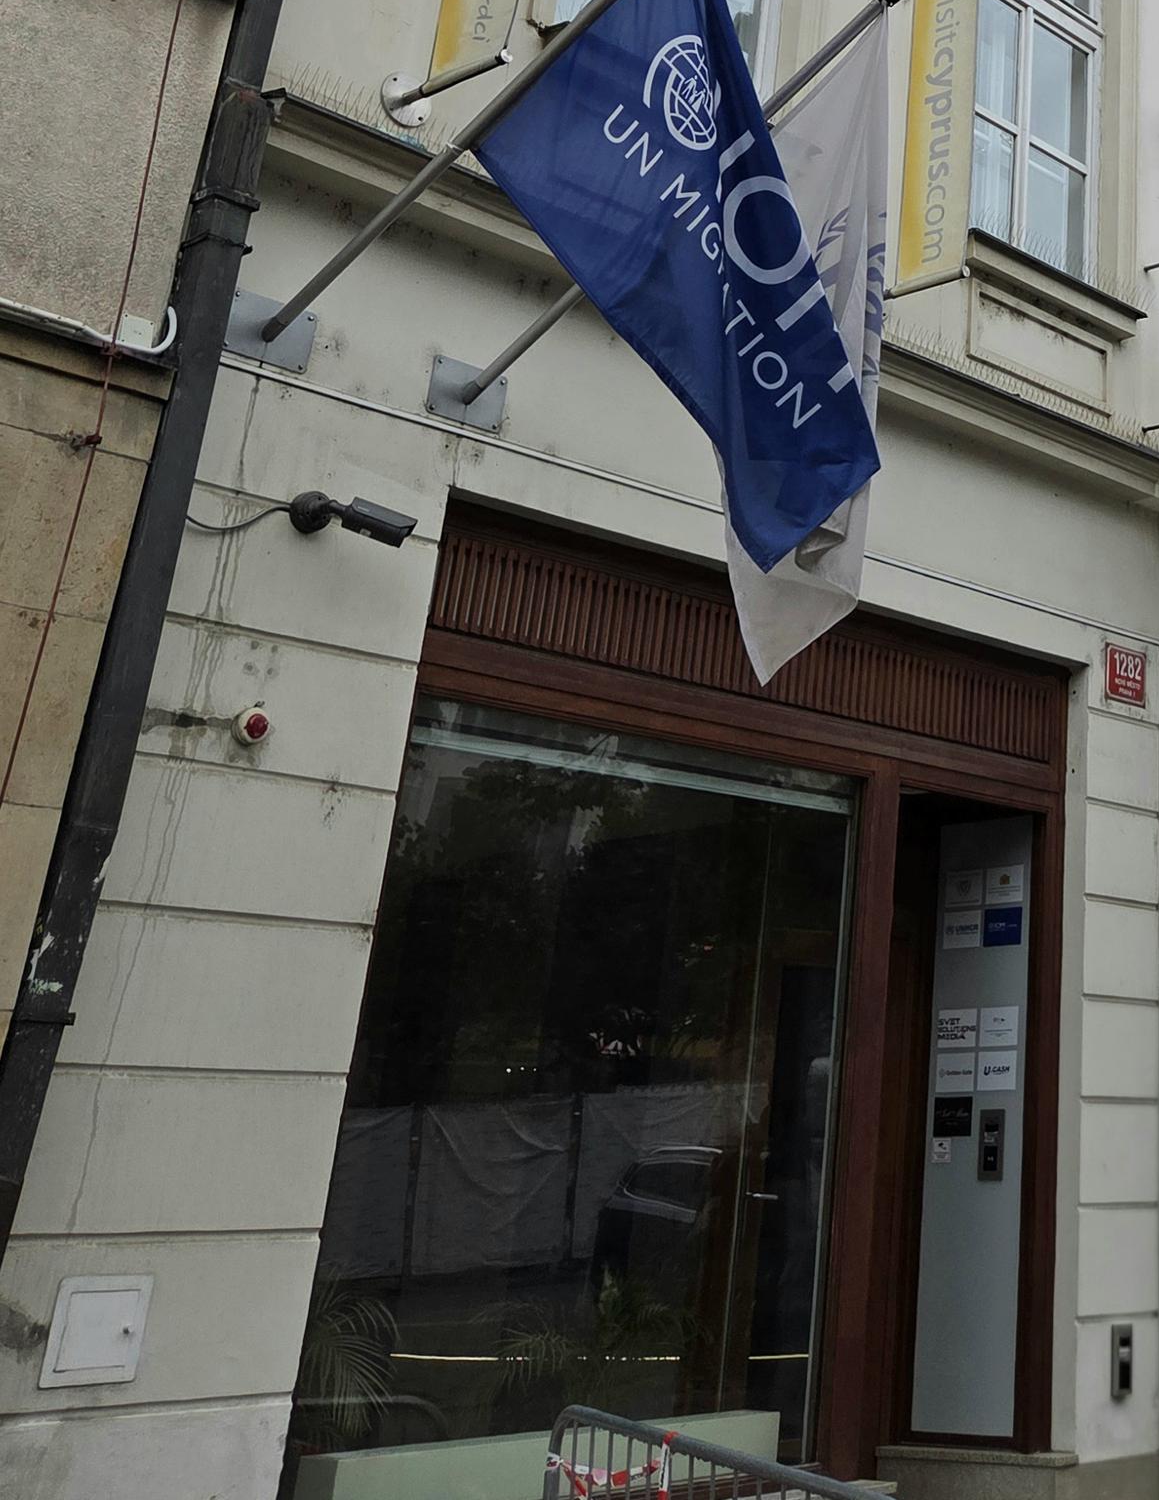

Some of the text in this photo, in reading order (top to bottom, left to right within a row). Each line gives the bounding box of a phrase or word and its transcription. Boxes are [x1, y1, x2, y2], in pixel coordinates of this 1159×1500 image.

[603, 103, 664, 178] UN
[659, 173, 822, 429] MIGTION
[1113, 652, 1142, 681] 1282
